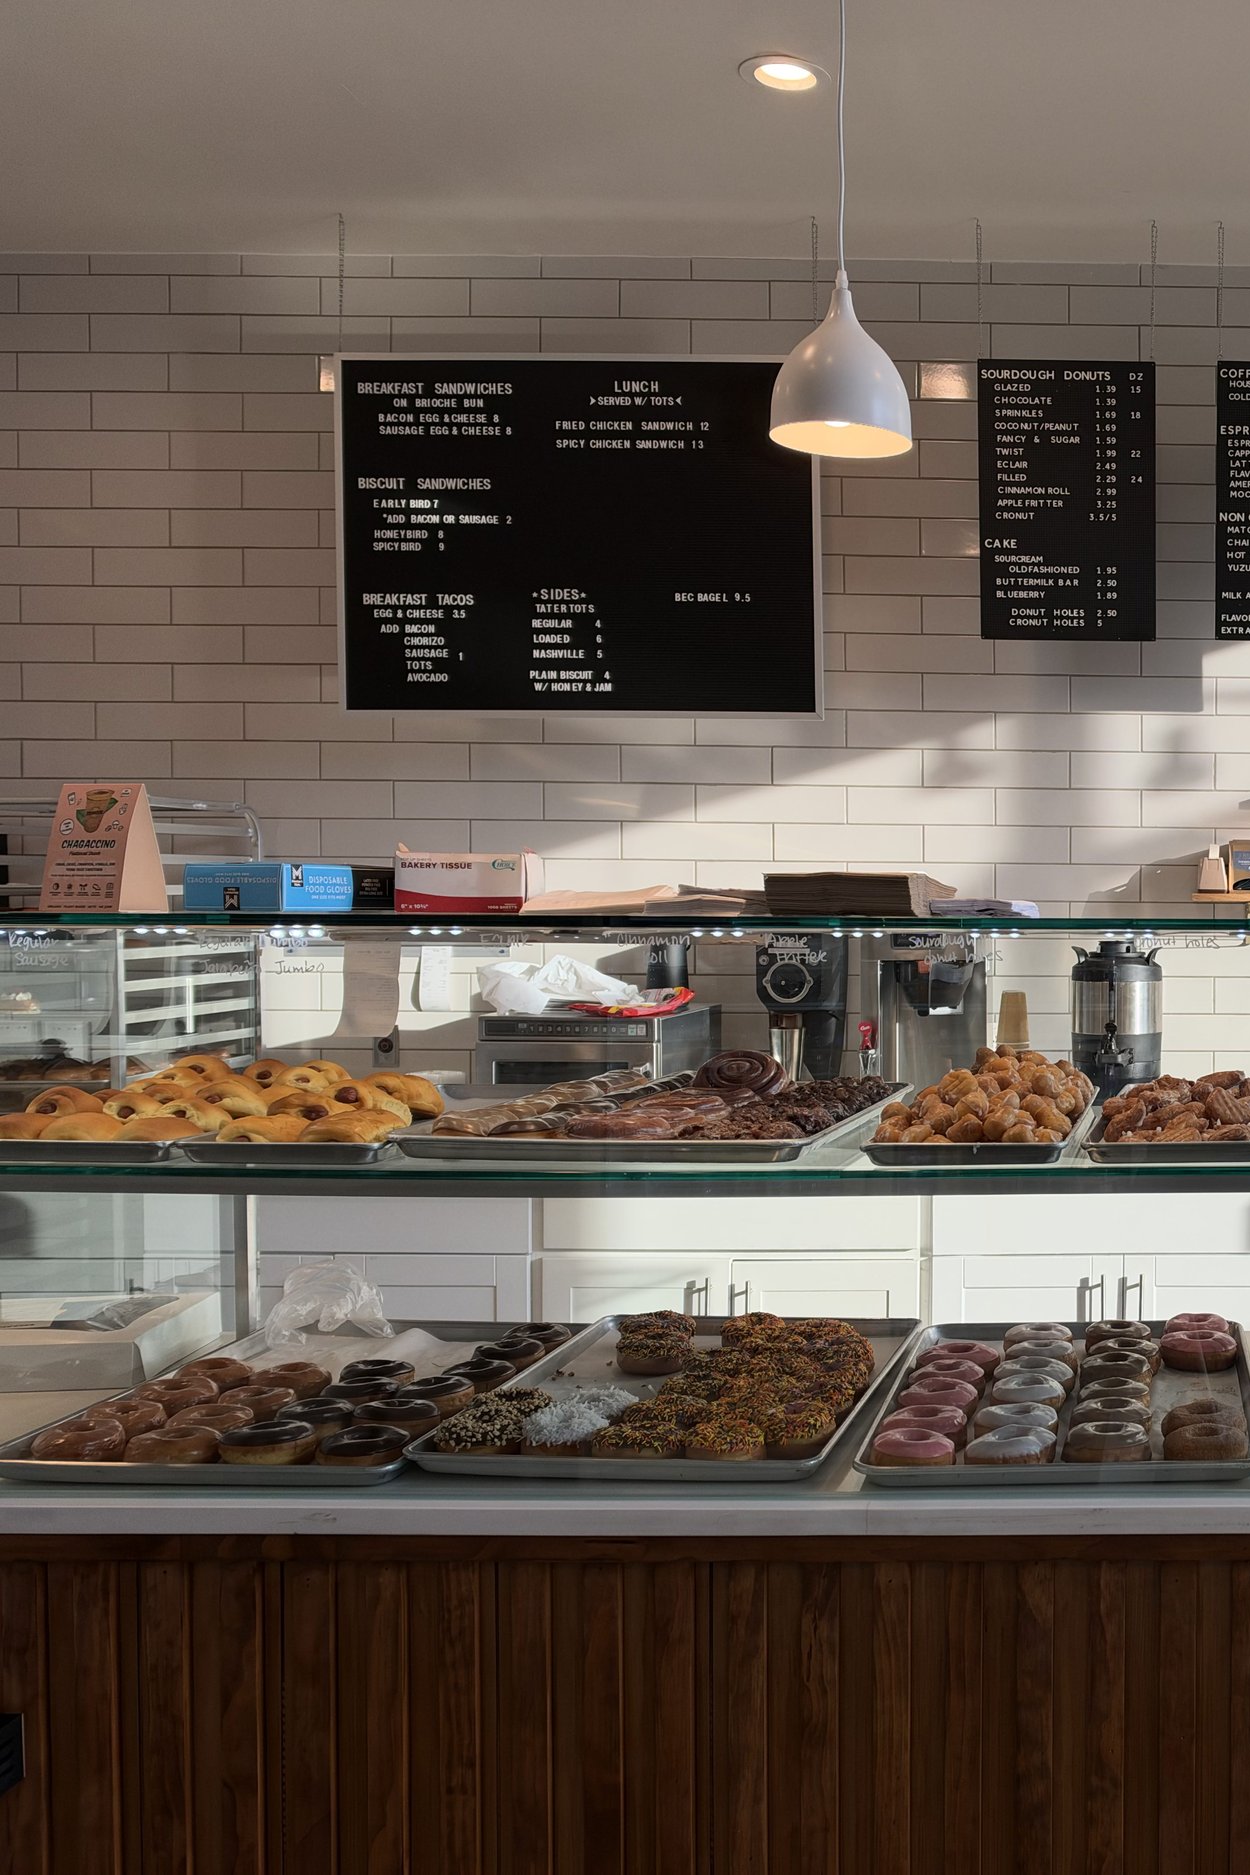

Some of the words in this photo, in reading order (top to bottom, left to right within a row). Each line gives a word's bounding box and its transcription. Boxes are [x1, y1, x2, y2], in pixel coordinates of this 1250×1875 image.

[980, 368, 1055, 380] SOURDOUGH
[1063, 370, 1111, 381] DONUTS
[357, 382, 425, 395] BREAKFAST
[434, 382, 513, 395] SANDWICHES
[614, 380, 659, 393] LUNCH
[993, 383, 1032, 392] GLAZED
[1095, 384, 1117, 393] 1.39
[1130, 385, 1142, 394] 15
[392, 397, 408, 408] ON
[415, 398, 458, 408] BRIOCHE
[463, 398, 484, 408] BUN
[597, 395, 632, 406] SERVED
[649, 396, 675, 406] TOTS
[993, 395, 1053, 405] CHOCOLATE
[1095, 397, 1117, 406] 1.39
[378, 413, 414, 423] BACON
[419, 413, 440, 423] EGG
[443, 413, 450, 423] &
[450, 413, 488, 424] CHEESE
[492, 413, 500, 424] 8
[378, 425, 425, 436] SAUSAGE
[429, 425, 450, 436] EGG
[451, 425, 459, 436] &
[461, 425, 501, 436] CHEESE
[505, 426, 512, 436] 8
[555, 420, 586, 431] FRIED
[589, 420, 633, 431] CHICKEN
[640, 421, 693, 431] SANDWICH
[700, 421, 710, 431] 12
[555, 438, 586, 449] SPICY
[589, 439, 631, 449] CHICKEN
[635, 439, 685, 450] SANDWICH
[357, 477, 406, 490] BISCUIT
[416, 477, 492, 490] SANDWICHES
[997, 473, 1027, 482] FILLED
[1095, 474, 1117, 483] 2.29
[1130, 475, 1143, 484] 24
[373, 498, 407, 509] EARLY
[409, 498, 432, 509] BIRD
[432, 499, 439, 509] 7
[996, 498, 1024, 508] APPLE
[1025, 499, 1064, 508] FRITTER
[1096, 500, 1117, 509] 3.25
[1219, 512, 1245, 522] NON
[984, 538, 1018, 549] CAKE
[995, 577, 1055, 587] BUTTERMILK
[1057, 578, 1079, 587] BAR
[1096, 579, 1118, 587] 2.50
[362, 593, 428, 606] BREAKFAST
[435, 593, 475, 606] TACOS
[697, 592, 729, 603] BAGEL
[734, 592, 751, 603] 9.5
[996, 590, 1046, 599] BLUEBERRY
[1096, 591, 1118, 600] 1.89
[373, 608, 393, 619] EGG
[396, 608, 404, 619] &
[406, 608, 445, 619] CHEESE
[1011, 608, 1046, 617] DONUT
[1053, 608, 1085, 617] HOLES
[1096, 609, 1118, 617] 2.50
[379, 623, 400, 634] ADD
[404, 624, 436, 634] BACON
[531, 618, 573, 629] REGULAR
[594, 619, 602, 629] 4
[403, 636, 445, 646] CHORIZO
[533, 633, 571, 644] LOADED
[595, 634, 603, 644] 6
[404, 648, 449, 658] SAUSAGE
[458, 651, 463, 661] 1
[532, 648, 585, 659] NASHVILLE
[596, 649, 603, 659] 5
[406, 672, 449, 683] AVOCADO
[61, 840, 116, 849] CHAGACCINO
[400, 861, 438, 870] BAKERY
[440, 862, 472, 870] TISSUE
[308, 875, 348, 884] DISPOSABLE
[305, 885, 325, 894] FOOD
[326, 885, 352, 894] GLOVES
[274, 960, 325, 975] Jumbo
